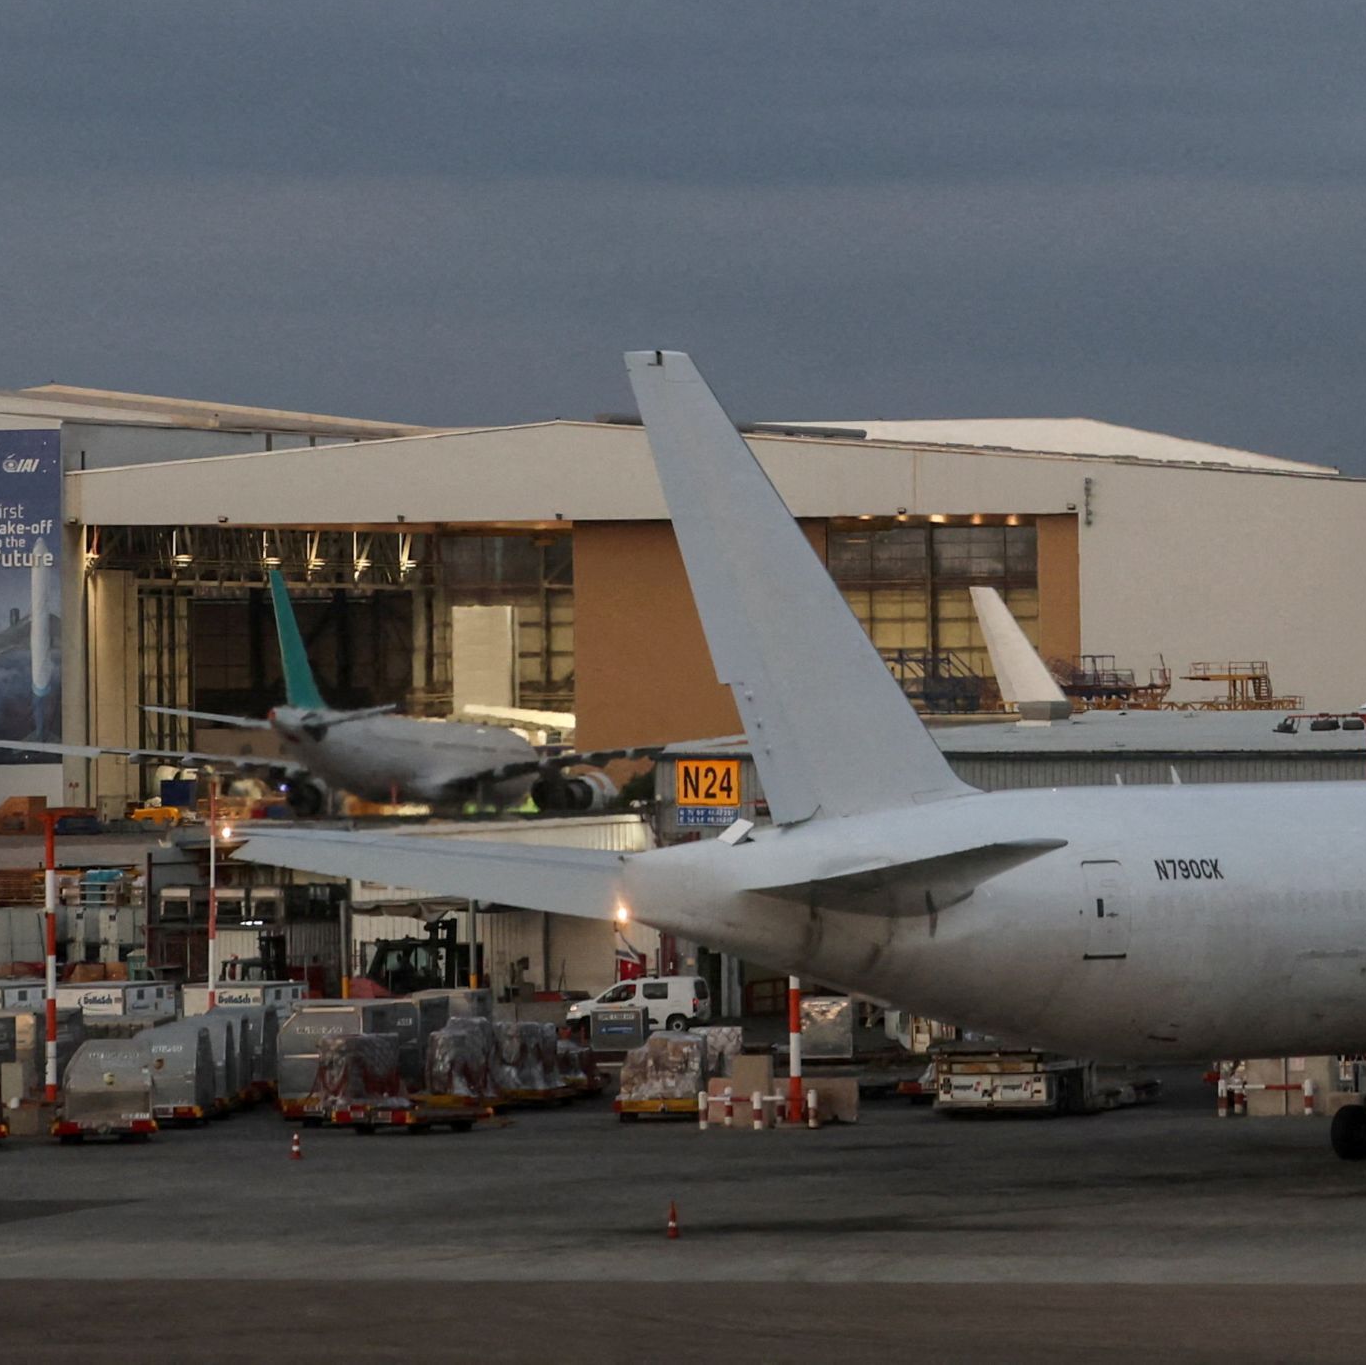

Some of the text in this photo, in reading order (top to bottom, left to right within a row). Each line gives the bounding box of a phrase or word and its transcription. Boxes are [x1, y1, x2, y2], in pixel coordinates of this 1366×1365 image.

[6, 536, 25, 548] the
[683, 765, 733, 799] N24
[1154, 858, 1224, 880] N790CK
